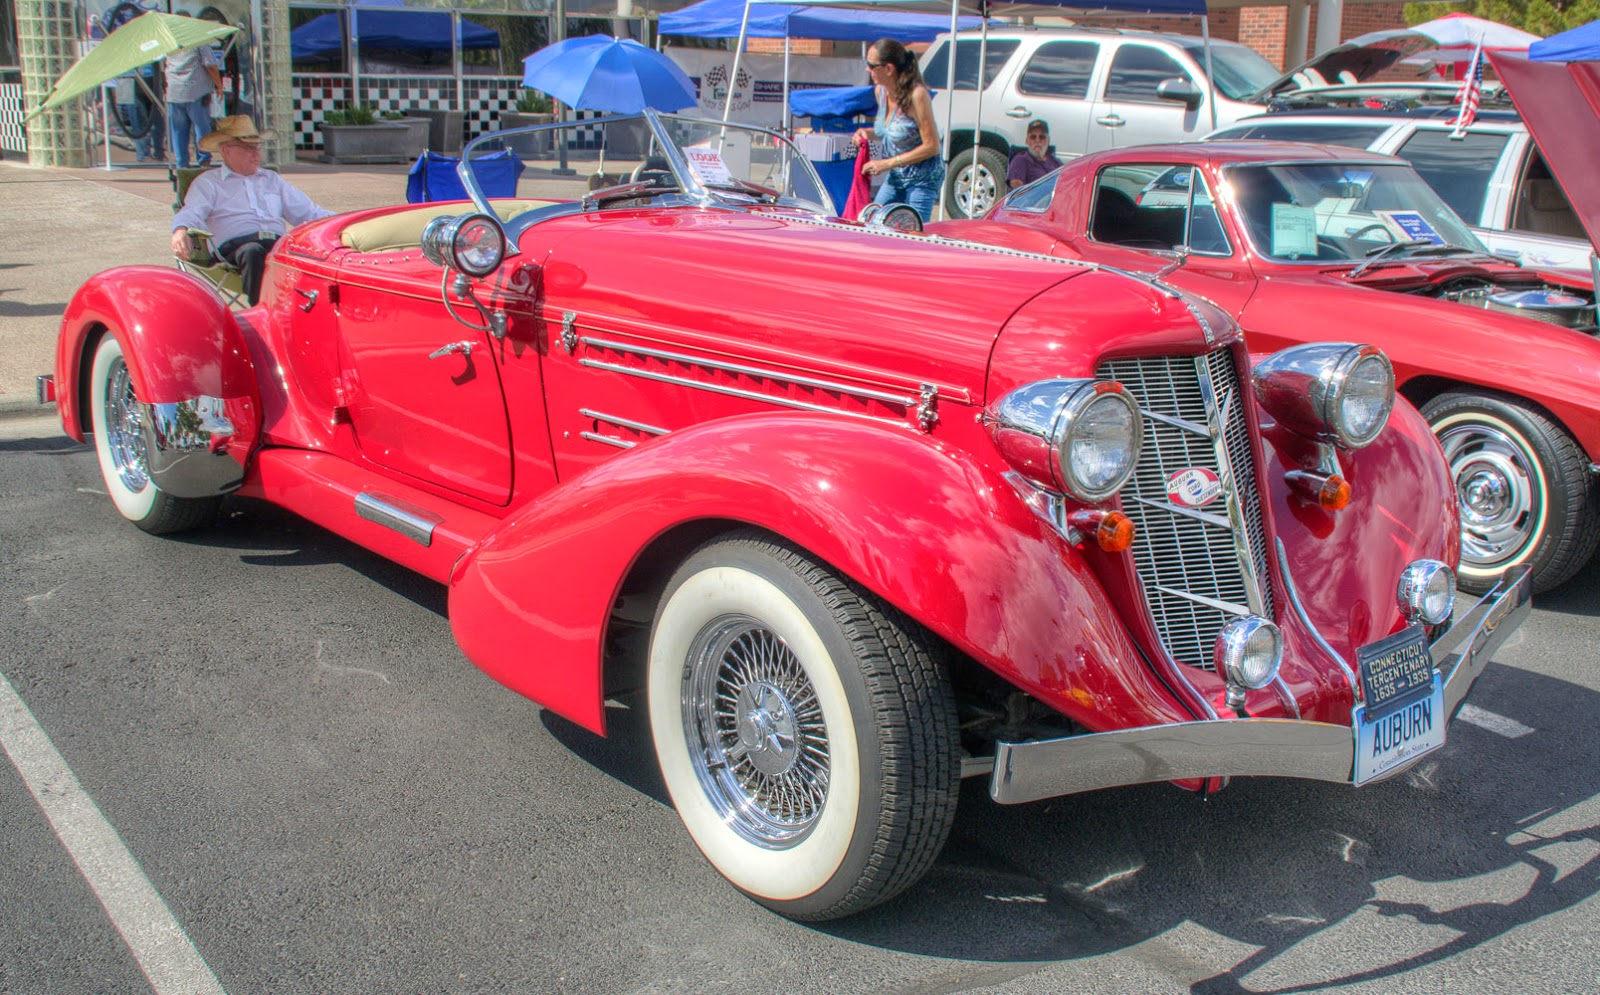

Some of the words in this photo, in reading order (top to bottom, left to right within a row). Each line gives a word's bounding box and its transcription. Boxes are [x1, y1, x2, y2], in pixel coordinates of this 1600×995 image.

[689, 152, 720, 162] LOOK
[1168, 471, 1194, 490] AUBURN
[1188, 481, 1201, 493] CORD
[1367, 653, 1429, 690] TERCENTENARY
[1369, 641, 1423, 675] CONNECTICUT
[1373, 682, 1396, 702] 1635
[1407, 668, 1429, 688] 1935
[1373, 698, 1432, 758] AUBURN
